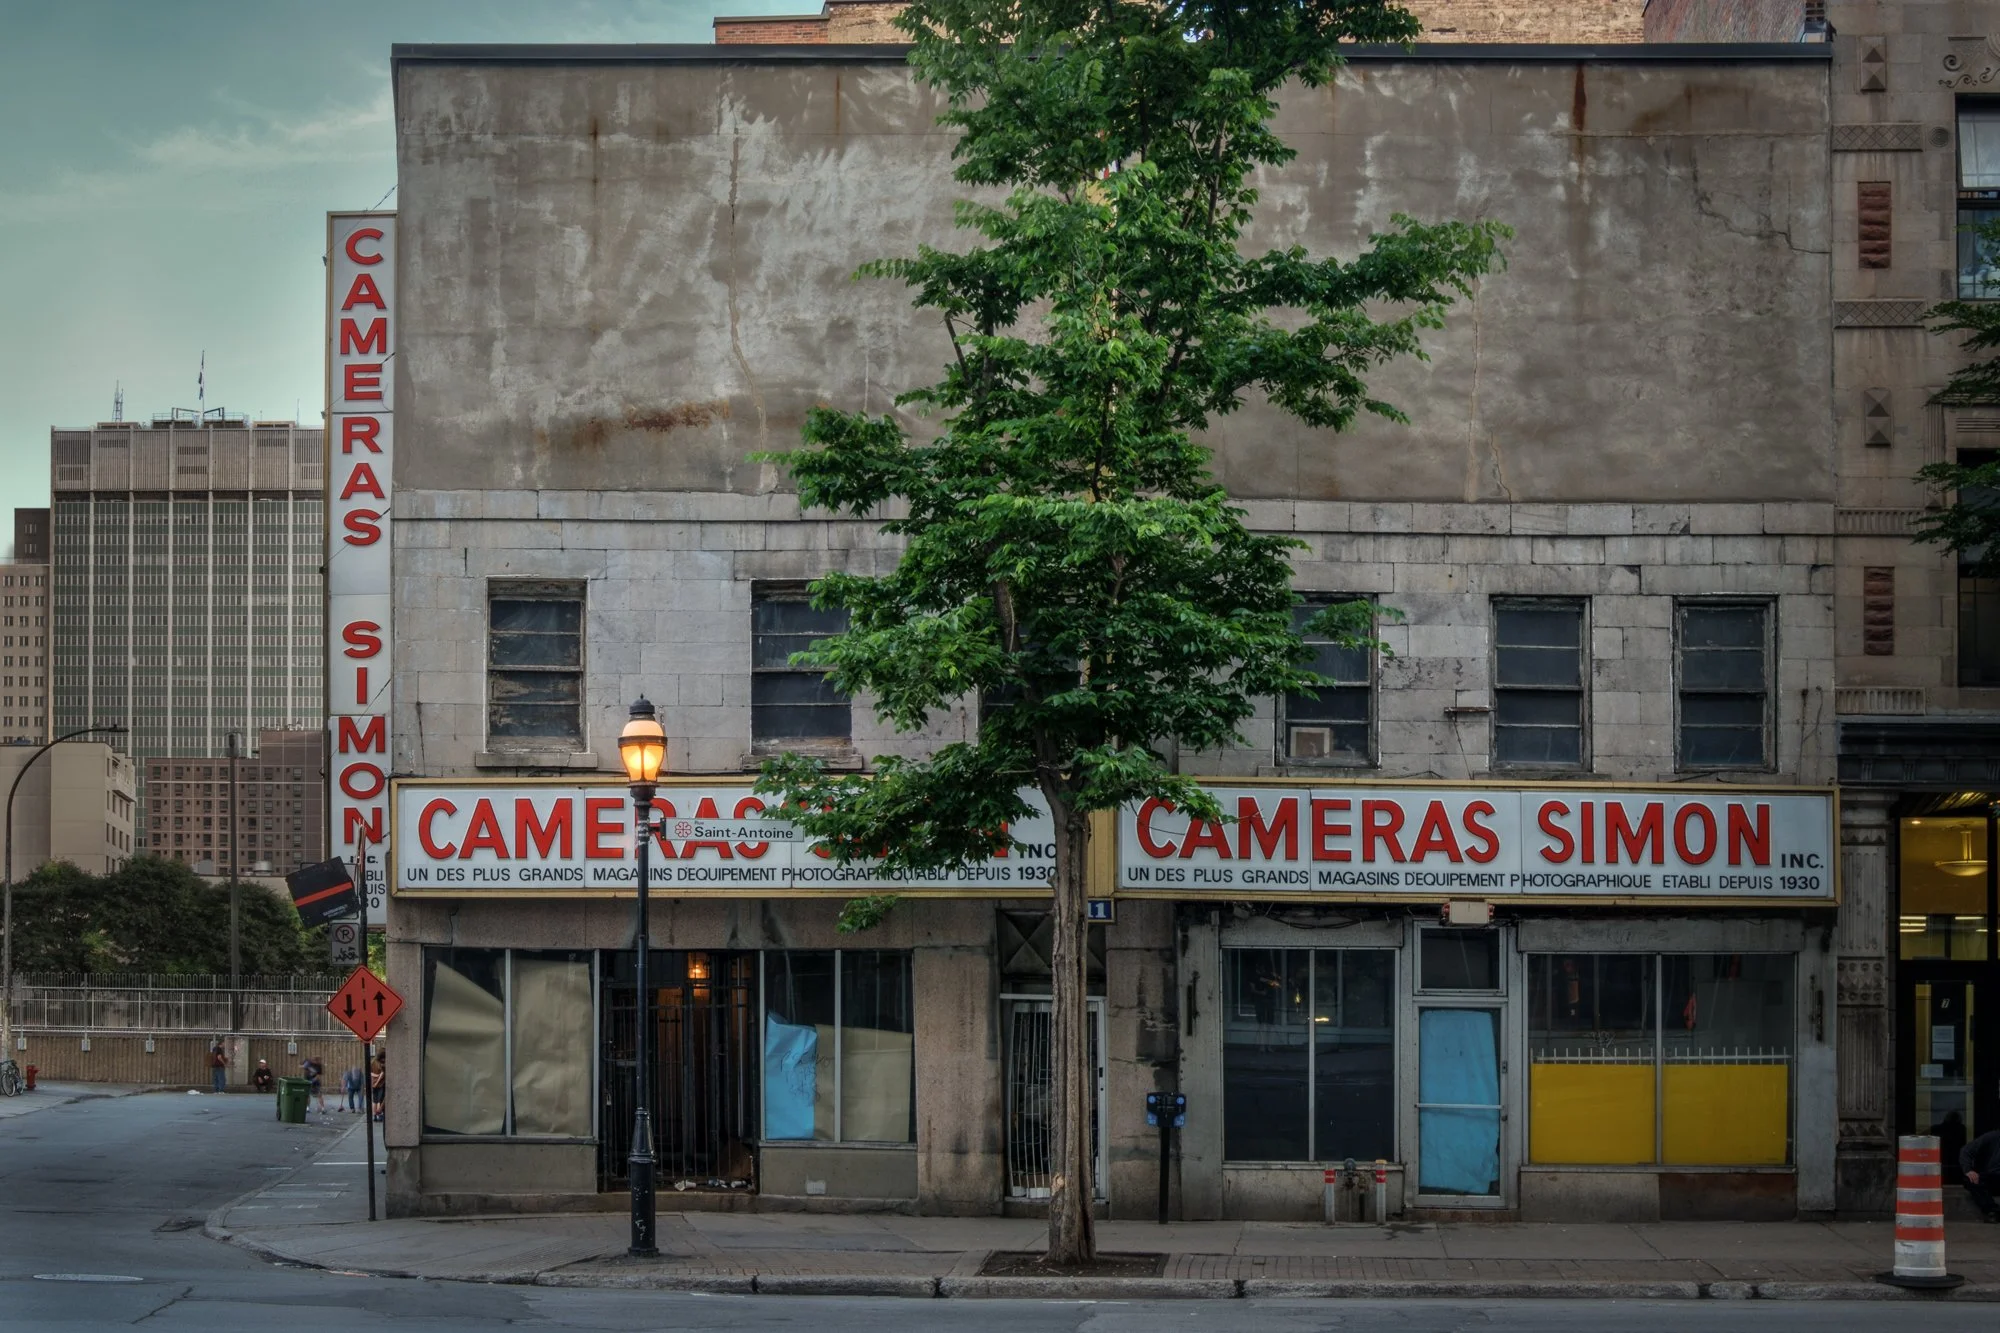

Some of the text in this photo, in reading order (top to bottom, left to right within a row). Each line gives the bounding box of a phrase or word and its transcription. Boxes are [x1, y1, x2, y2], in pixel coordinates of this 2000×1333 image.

[339, 227, 388, 546] CAMERAS
[338, 620, 386, 844] SIMON
[694, 826, 793, 839] Saint-Antoine
[1136, 795, 1772, 866] CAMERAS SIMON
[1781, 852, 1824, 869] INC.
[407, 867, 428, 882] UN
[436, 867, 465, 882] DES
[473, 867, 511, 882] PLUS
[519, 867, 583, 882] GRANDS
[593, 867, 672, 882] MAGAINS
[957, 866, 1011, 881] DEPUIS
[1128, 868, 1149, 882] UN
[1155, 868, 1185, 883] DES
[1194, 869, 1233, 883] PLUS
[1242, 870, 1309, 885] GRANDS
[1319, 871, 1400, 886] MAGASINS
[1510, 873, 1652, 889] PHOTOGRAPHIQUE
[1662, 874, 1711, 889] ETABLI
[1719, 875, 1773, 890] DEPUIS
[1780, 876, 1820, 890] 1930
